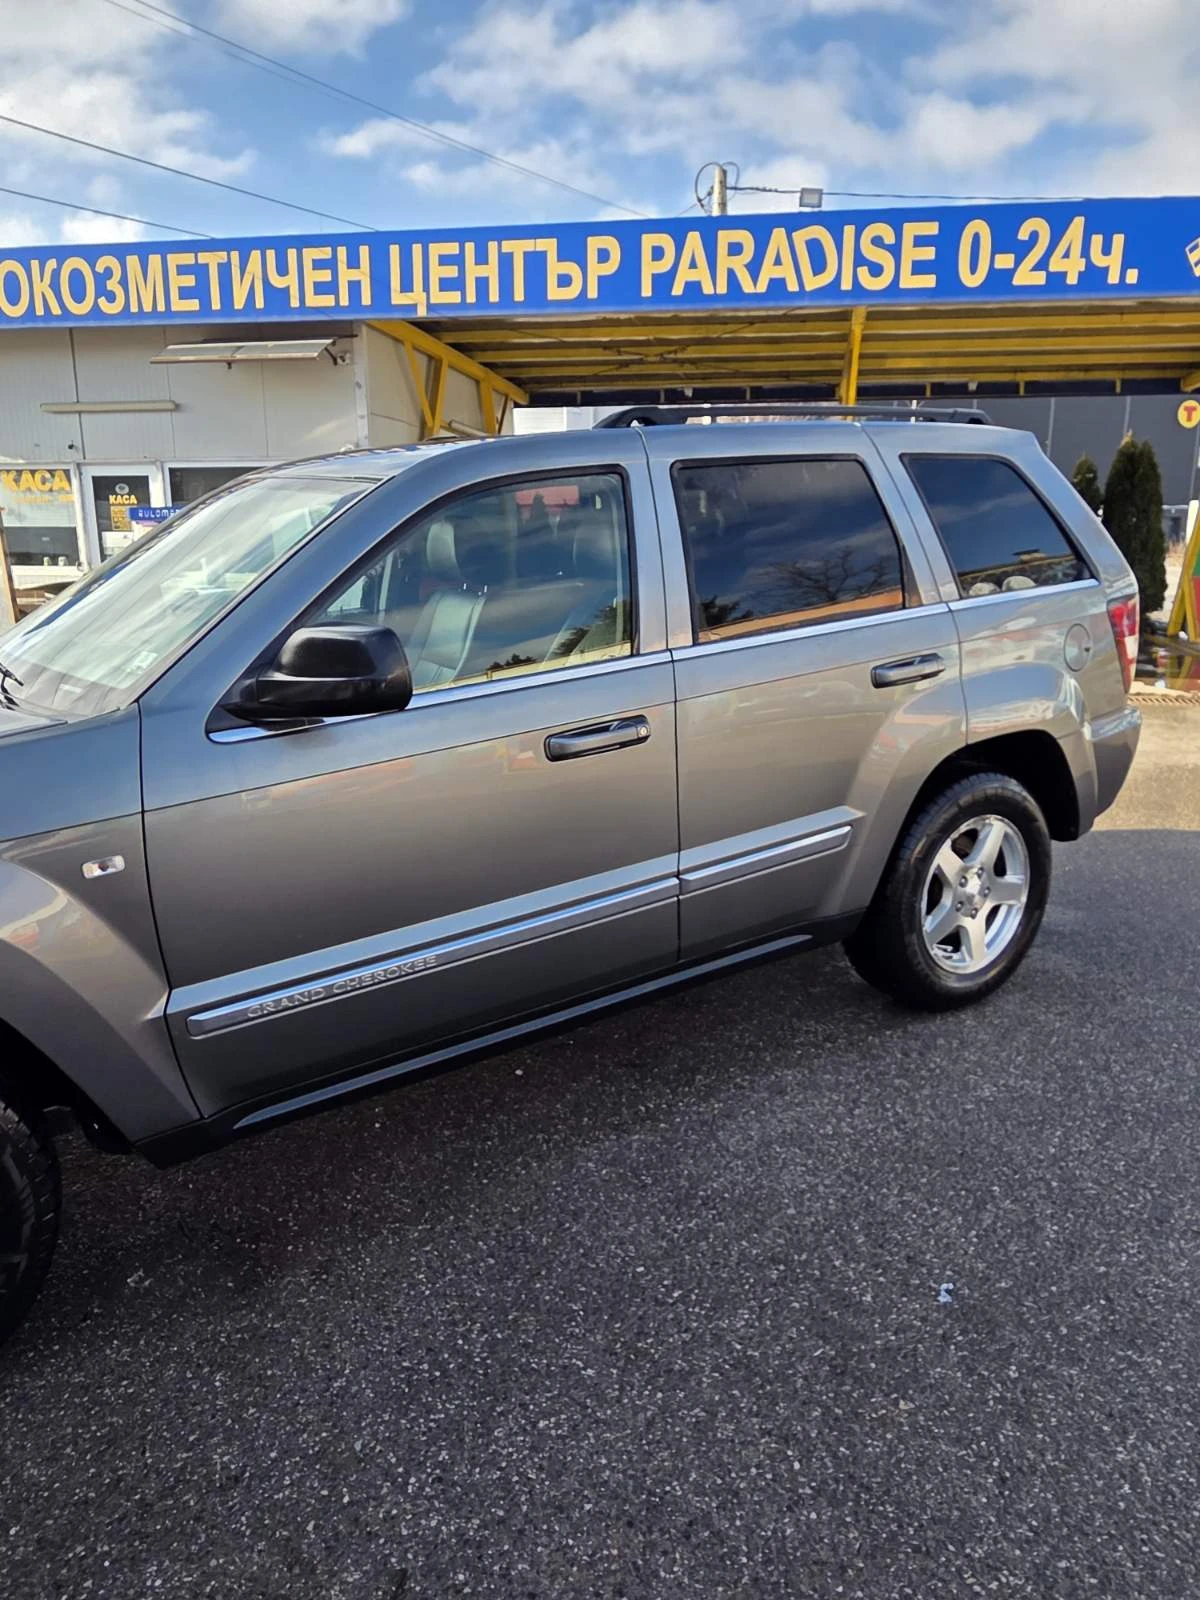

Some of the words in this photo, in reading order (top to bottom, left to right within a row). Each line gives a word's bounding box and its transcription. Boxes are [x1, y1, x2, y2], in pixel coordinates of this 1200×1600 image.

[389, 235, 621, 317] ЦЕНТЪР
[641, 221, 939, 297] PARADISE
[1, 470, 72, 492] КАСА
[108, 494, 138, 505] КАСА
[247, 988, 326, 1018] GRAND
[332, 955, 437, 994] CHEROKEE
